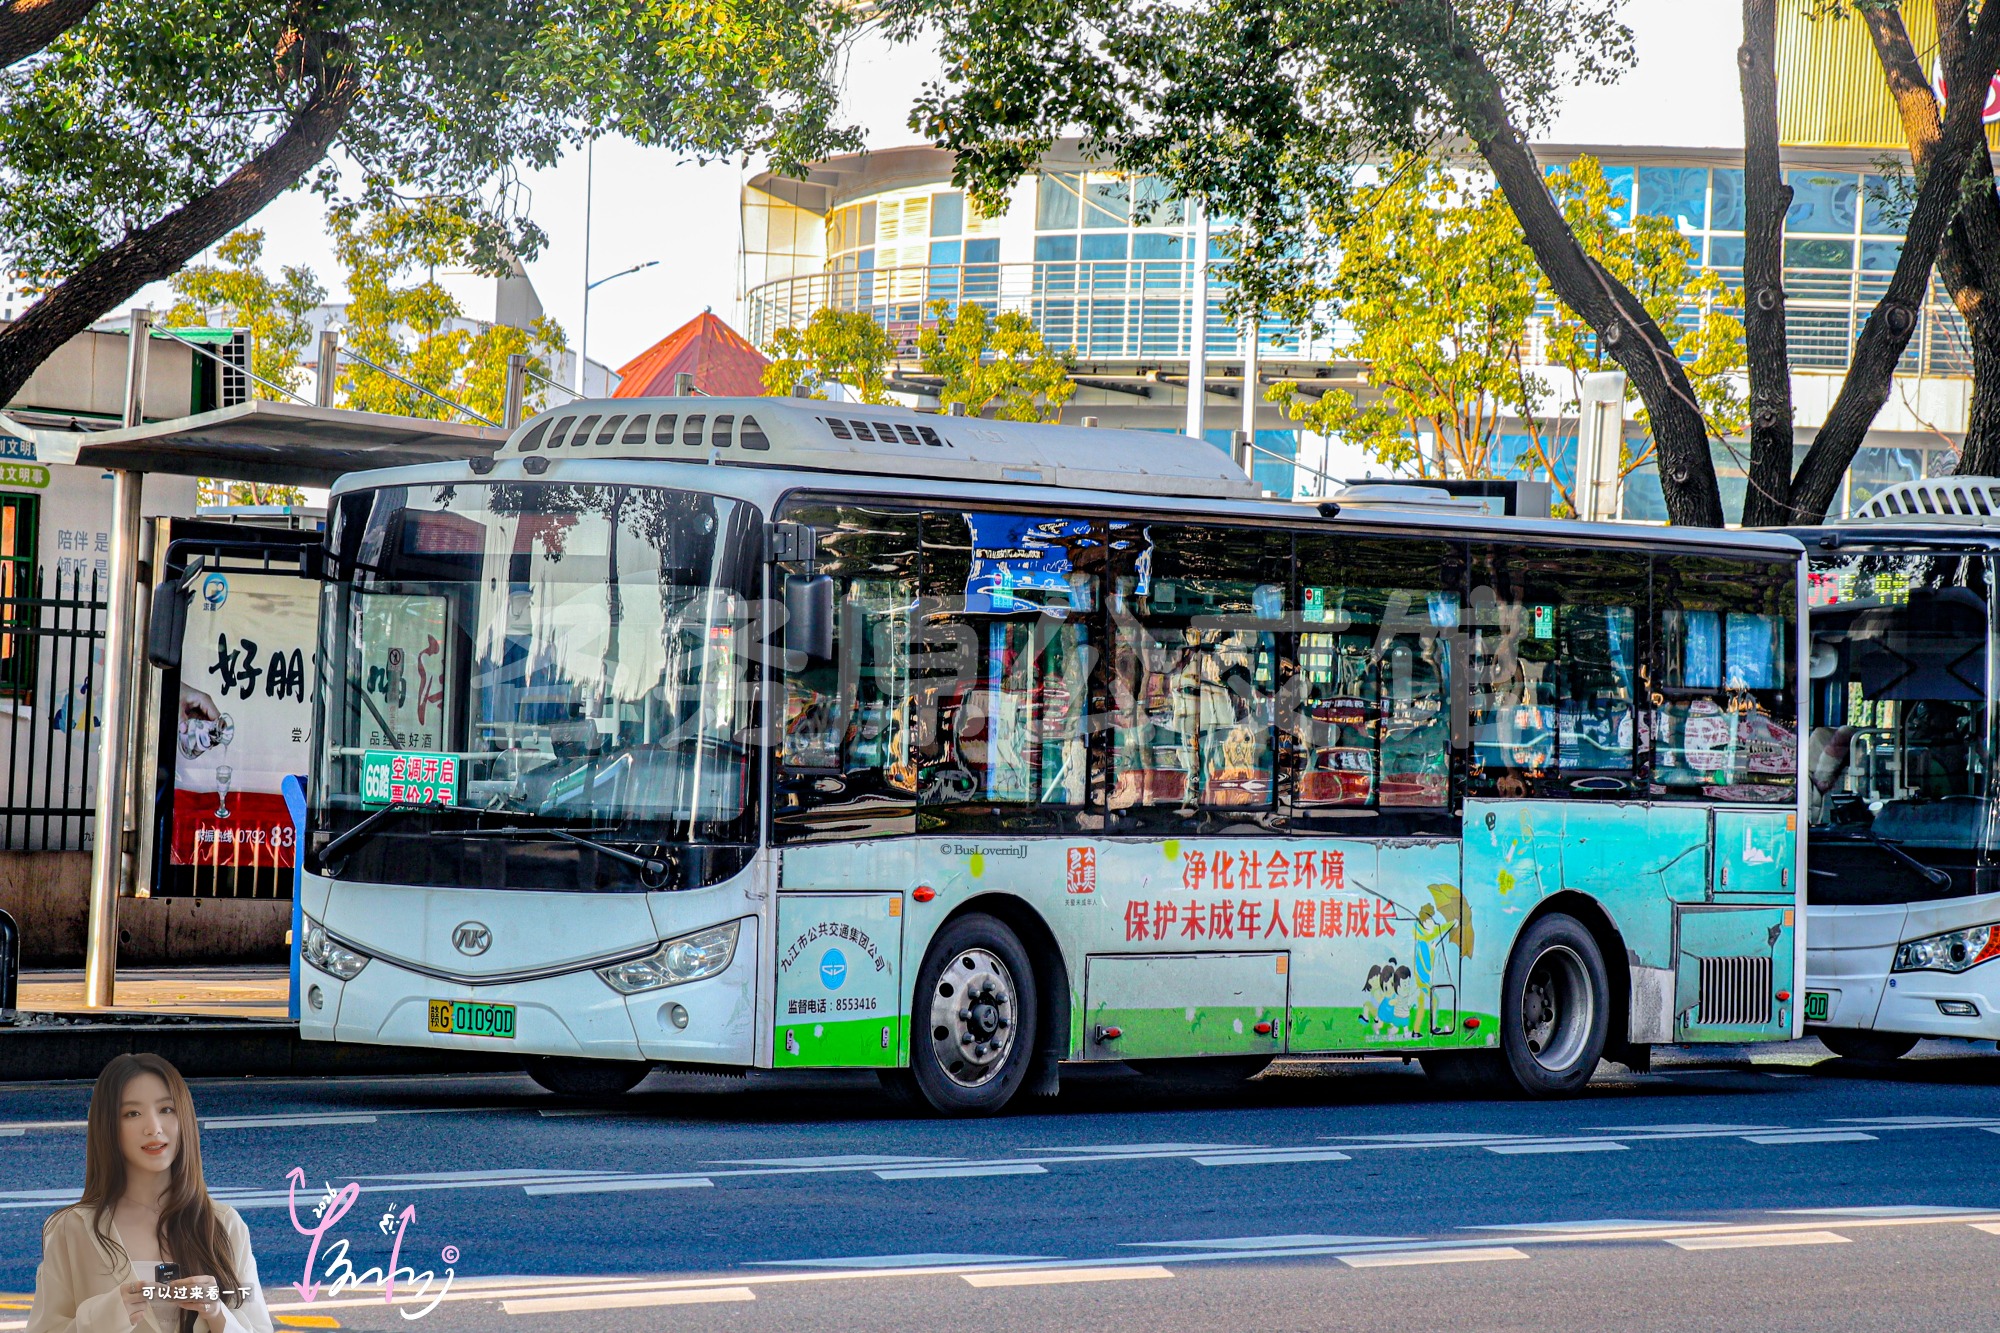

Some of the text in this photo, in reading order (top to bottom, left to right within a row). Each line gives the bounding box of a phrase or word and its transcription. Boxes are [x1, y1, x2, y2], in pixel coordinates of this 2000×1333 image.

[57, 529, 109, 553] 陪伴 是
[56, 556, 108, 580] 倾听 是
[208, 632, 314, 704] 好朋
[365, 763, 390, 799] 66路
[391, 756, 455, 784] 空调开启
[390, 784, 453, 809] 票价2元
[238, 829, 266, 844] 0792
[270, 826, 294, 848] 83
[1182, 849, 1345, 891] 净化社会环境
[1123, 898, 1397, 942] 保护未成年人健康成长
[780, 921, 885, 973] 九江市公共交通集团公司
